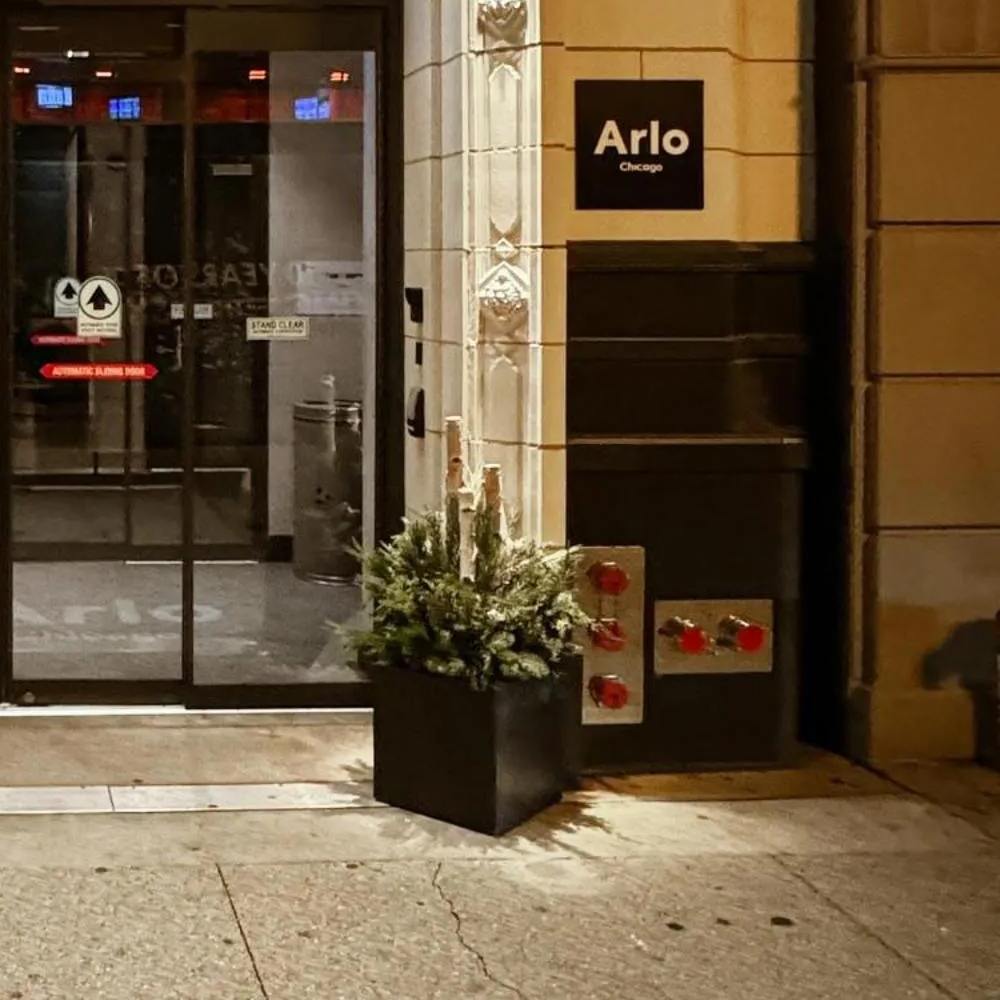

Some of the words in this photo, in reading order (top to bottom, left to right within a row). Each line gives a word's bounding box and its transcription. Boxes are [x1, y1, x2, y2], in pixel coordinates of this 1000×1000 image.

[593, 119, 690, 156] Arlo
[619, 161, 663, 174] Chicago
[251, 320, 277, 329] STAND
[278, 320, 305, 329] CLEAR
